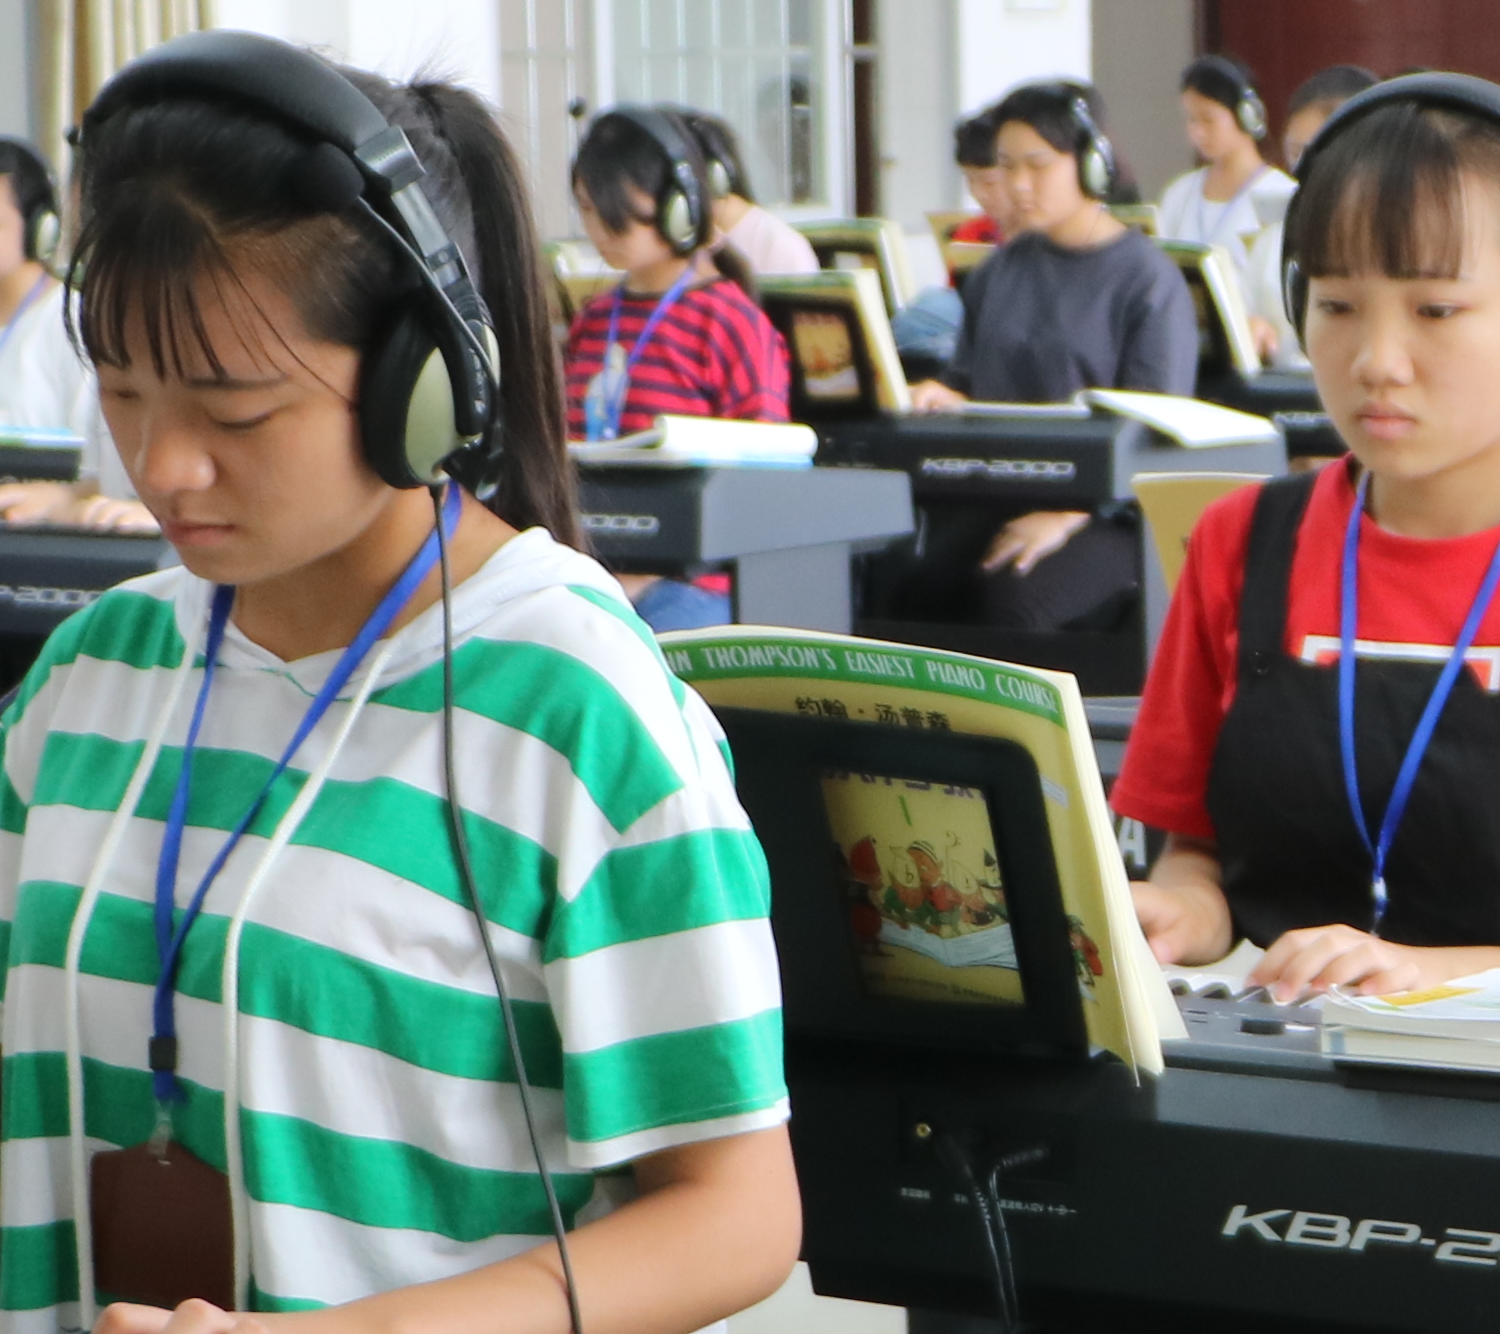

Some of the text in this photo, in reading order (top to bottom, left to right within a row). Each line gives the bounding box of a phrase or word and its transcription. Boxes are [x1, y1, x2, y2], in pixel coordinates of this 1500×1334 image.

[700, 645, 837, 671] THOMPSON'S
[844, 651, 916, 679] EASIEST
[925, 660, 986, 690] PIANO
